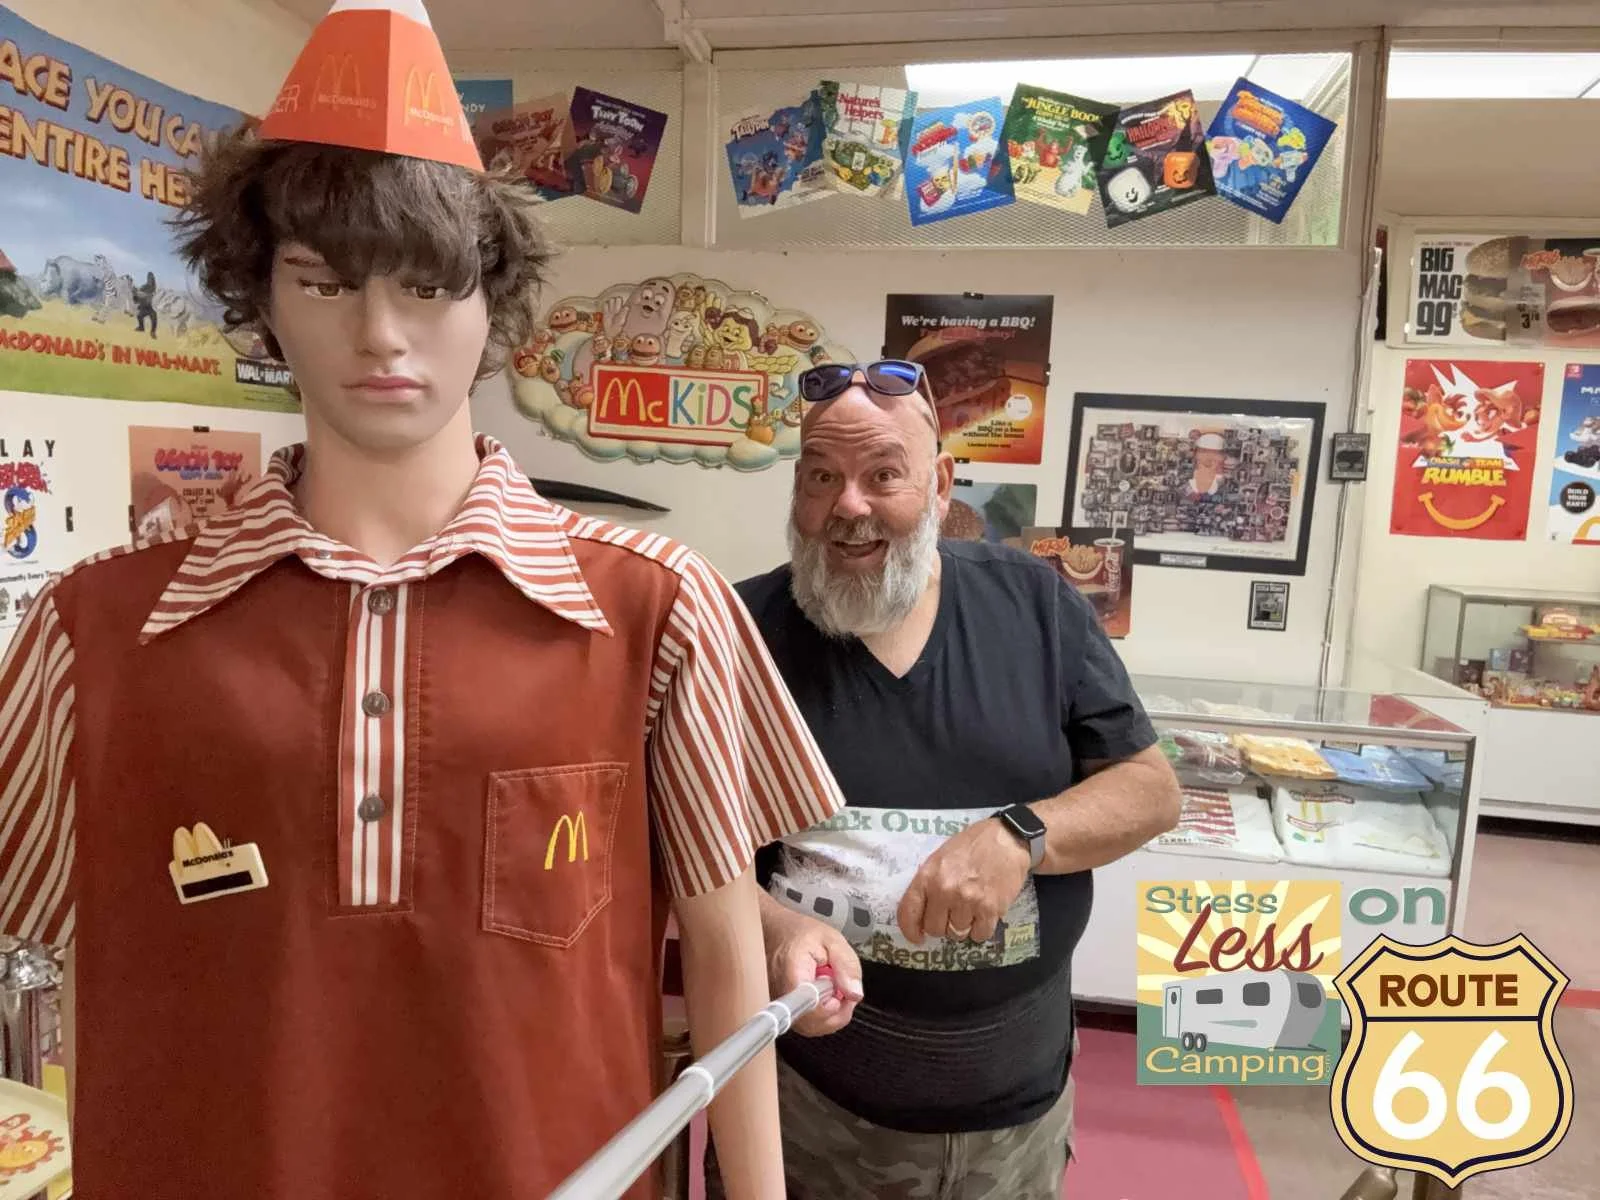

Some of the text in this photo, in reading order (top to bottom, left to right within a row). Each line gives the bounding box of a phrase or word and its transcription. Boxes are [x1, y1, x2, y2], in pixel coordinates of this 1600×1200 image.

[85, 75, 166, 147] YOU
[844, 106, 884, 121] Helpers
[1420, 248, 1454, 273] BIG
[1418, 274, 1463, 300] MAC
[901, 315, 1036, 330] We're having a BBQ!
[111, 344, 132, 365] IN
[1421, 467, 1506, 486] RUMBLE
[182, 850, 234, 868] McDonald's
